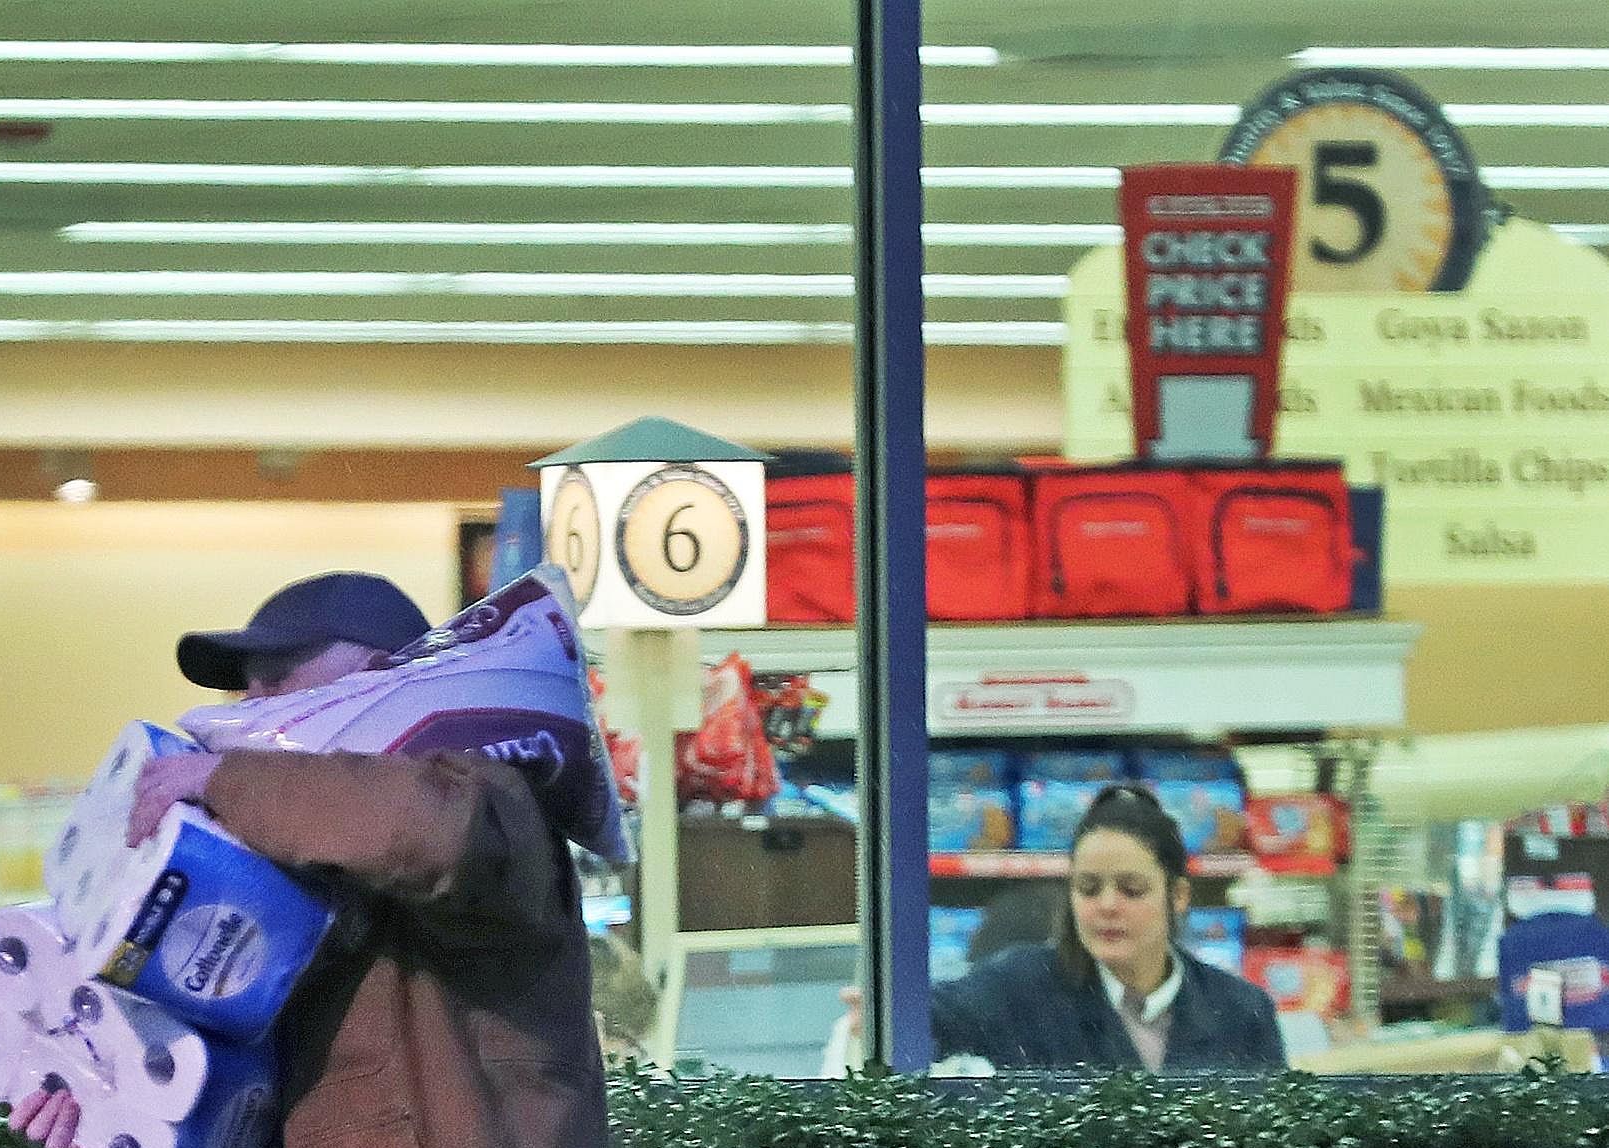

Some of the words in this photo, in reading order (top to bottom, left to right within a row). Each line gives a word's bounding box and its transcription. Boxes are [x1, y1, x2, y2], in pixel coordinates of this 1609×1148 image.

[1308, 139, 1387, 266] 5
[1143, 231, 1270, 271] CHECK
[1146, 271, 1268, 312] PRICE
[1148, 312, 1263, 353] HERE
[1357, 377, 1503, 413] Mexican
[663, 501, 701, 573] 6
[1445, 518, 1537, 558] Salsa
